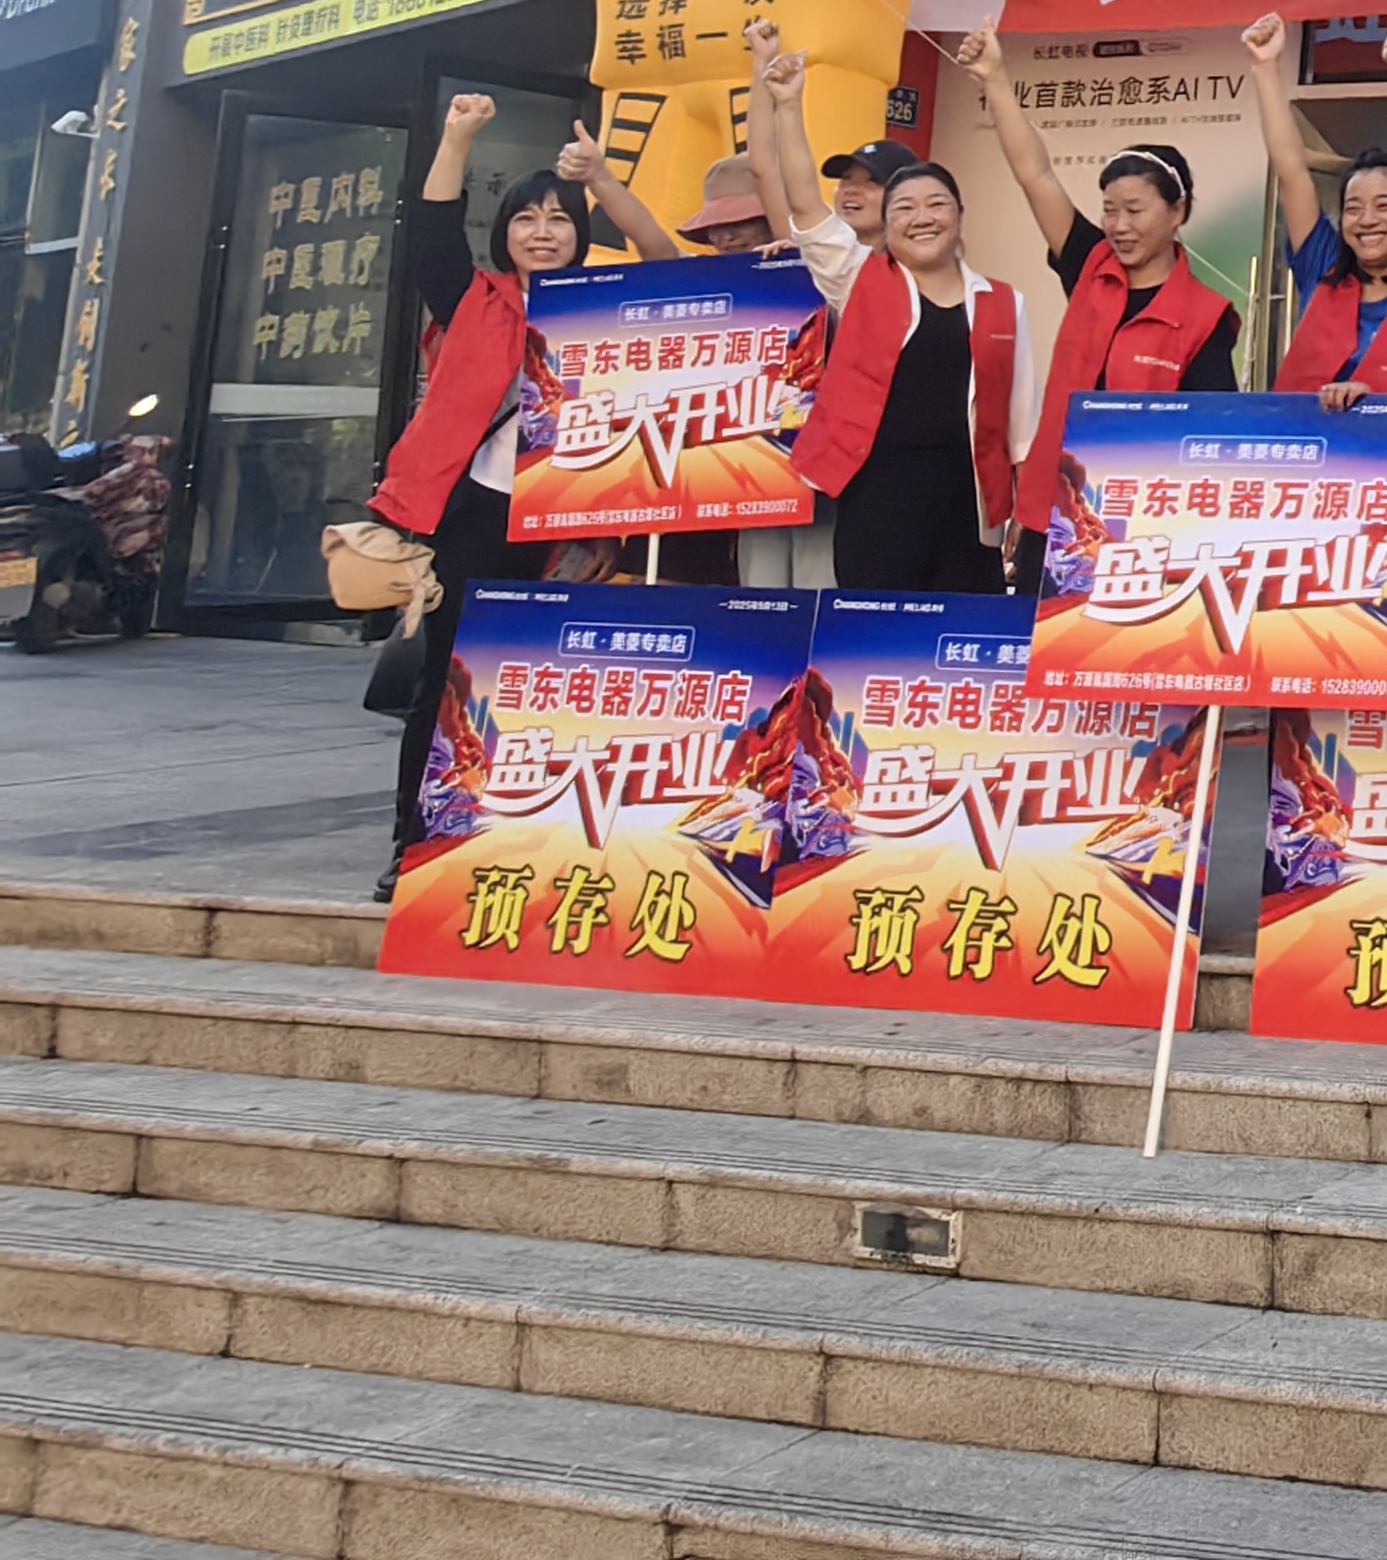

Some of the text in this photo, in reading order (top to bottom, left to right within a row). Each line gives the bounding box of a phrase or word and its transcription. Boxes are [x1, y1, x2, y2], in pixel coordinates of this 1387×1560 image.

[615, 16, 772, 65] 幸福一
[1207, 74, 1246, 101] TV
[269, 166, 383, 229] 中医内科
[560, 326, 789, 379] 雪东电器万源店
[551, 375, 786, 489] 盛大开业
[495, 662, 752, 724] 雪东电器万源店
[480, 726, 736, 850] 盛大开业
[851, 744, 1149, 873] 盛大开业
[461, 865, 697, 962] 预存处
[846, 885, 1113, 988] 预存处
